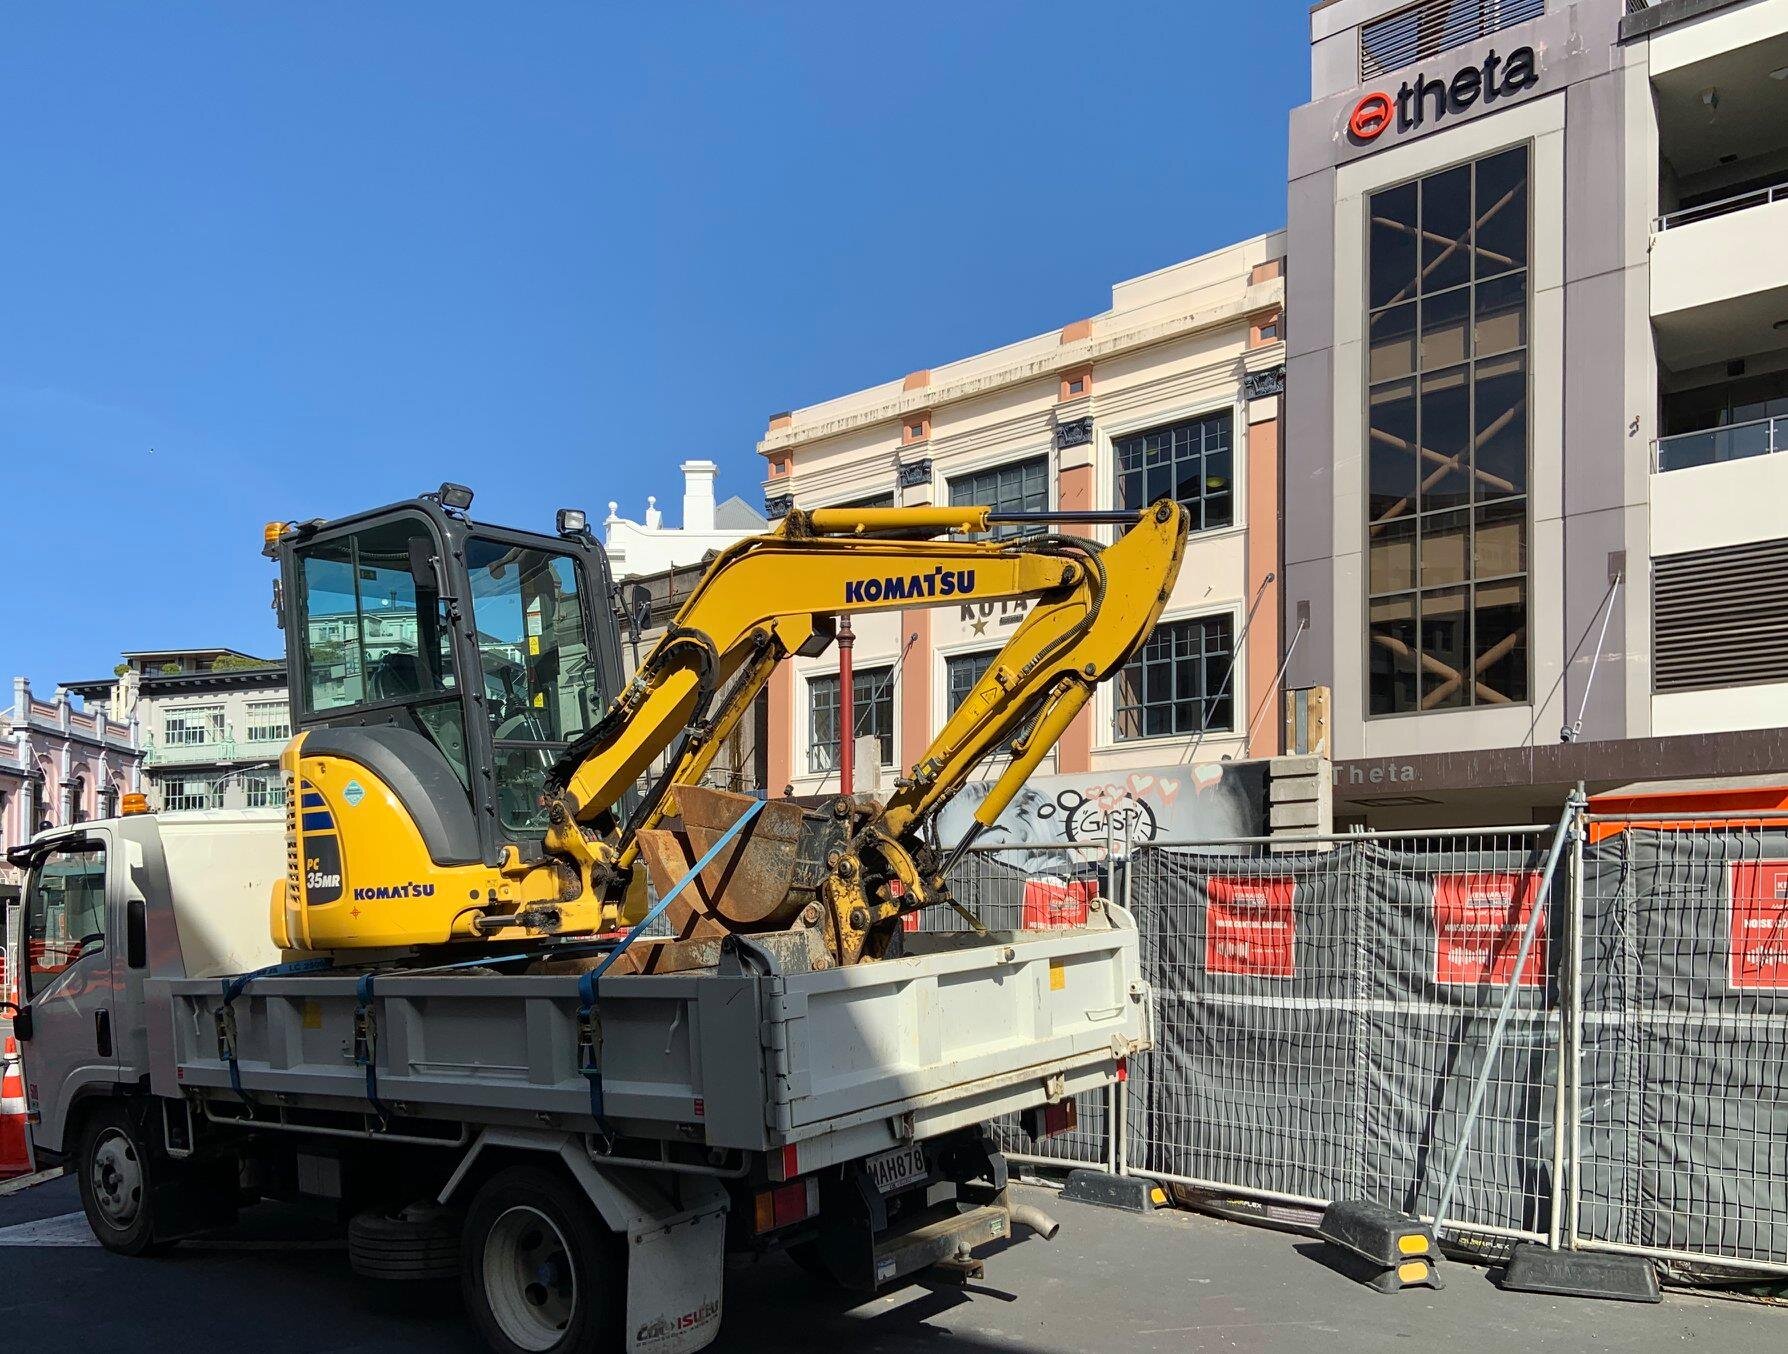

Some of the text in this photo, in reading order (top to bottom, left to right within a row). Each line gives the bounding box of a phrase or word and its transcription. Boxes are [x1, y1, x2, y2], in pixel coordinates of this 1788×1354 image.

[1395, 46, 1539, 133] theta
[846, 566, 975, 603] KOMATSU
[1332, 763, 1415, 785] Theta
[307, 858, 320, 870] PC
[307, 872, 340, 888] 35MR
[354, 882, 435, 901] KOMATSU
[1744, 918, 1773, 928] NOISE
